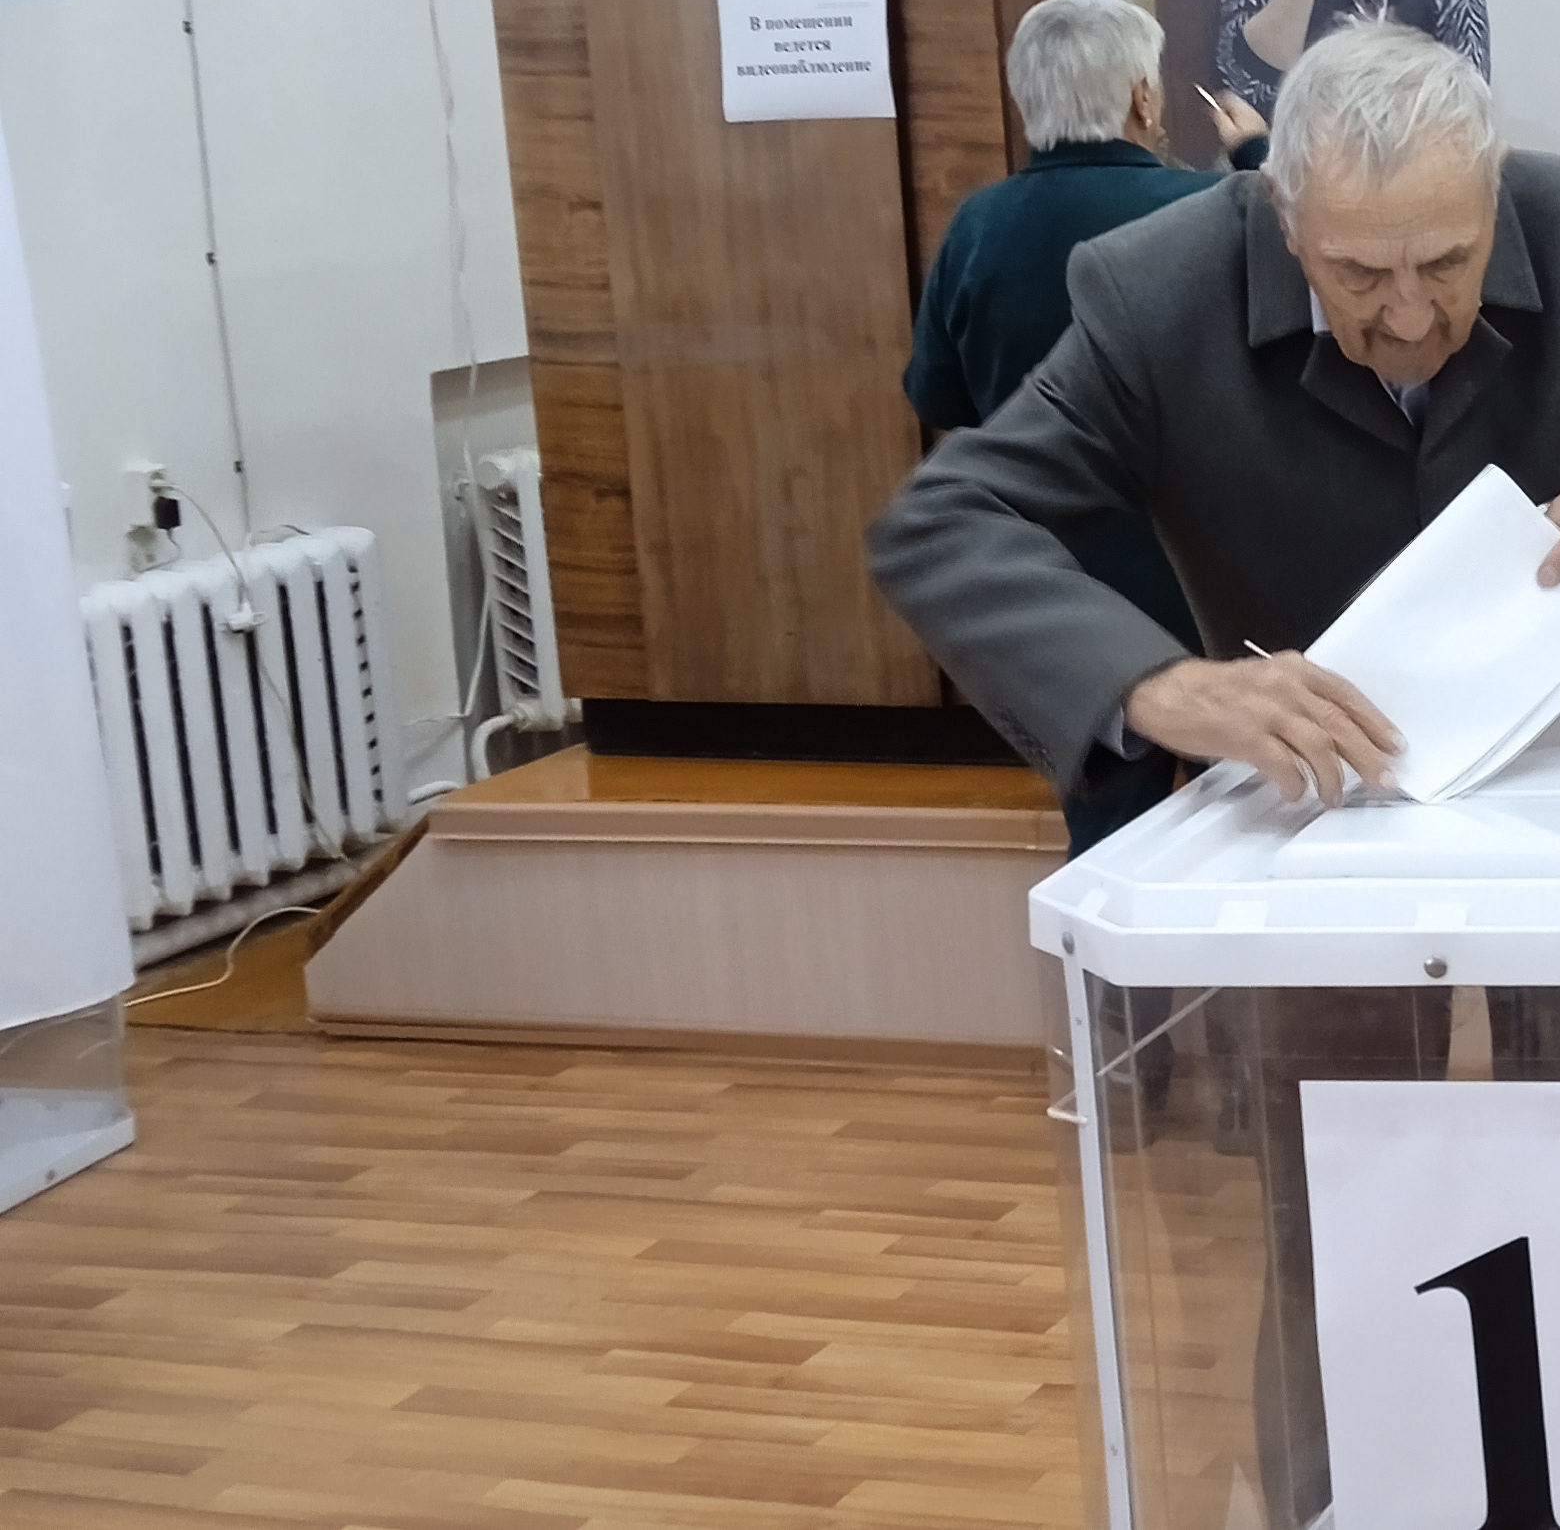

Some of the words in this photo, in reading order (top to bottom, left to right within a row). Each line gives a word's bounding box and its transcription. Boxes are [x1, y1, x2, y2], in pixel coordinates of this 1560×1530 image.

[749, 15, 761, 31] В
[765, 15, 853, 30] помещении
[774, 39, 832, 53] ведется
[736, 59, 872, 77] видеонаблюдение
